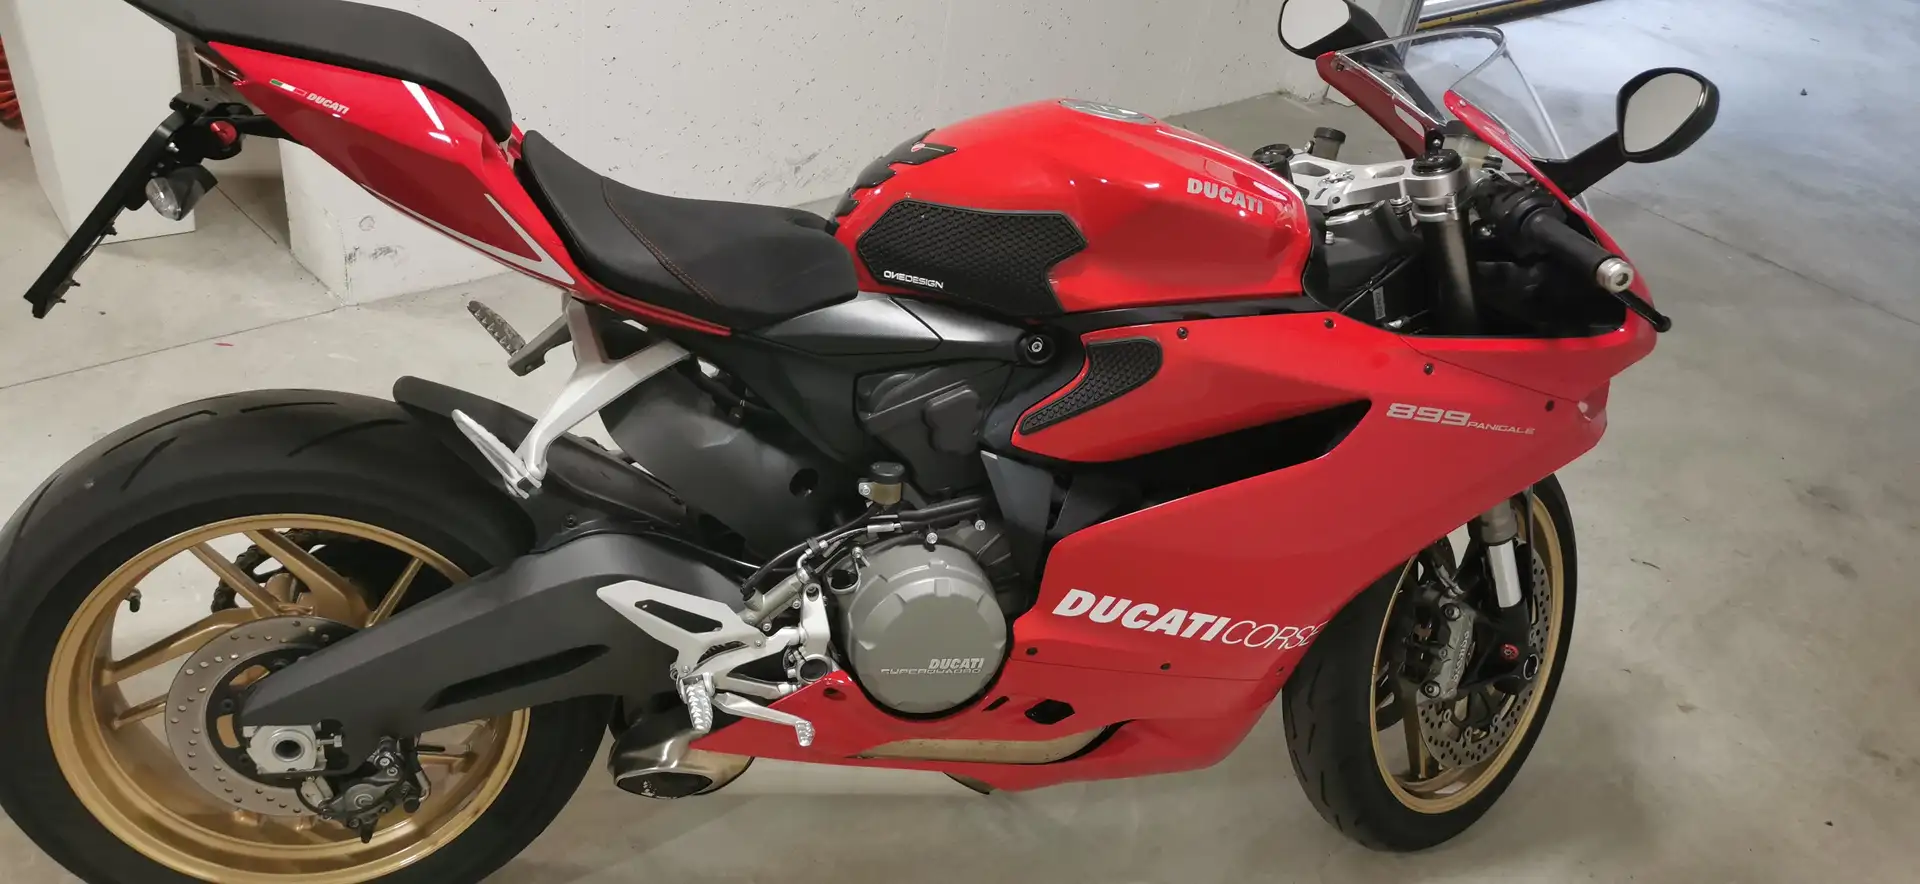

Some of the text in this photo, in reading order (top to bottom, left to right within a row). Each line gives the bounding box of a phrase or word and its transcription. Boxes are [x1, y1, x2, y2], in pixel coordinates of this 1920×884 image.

[306, 93, 350, 115] DUCATI
[1187, 177, 1263, 215] DUCATI
[883, 270, 944, 289] ONEDESIGN
[1386, 402, 1535, 435] 899 PANIGALE
[1052, 588, 1232, 642] DUCATI
[928, 657, 985, 670] DUCATI
